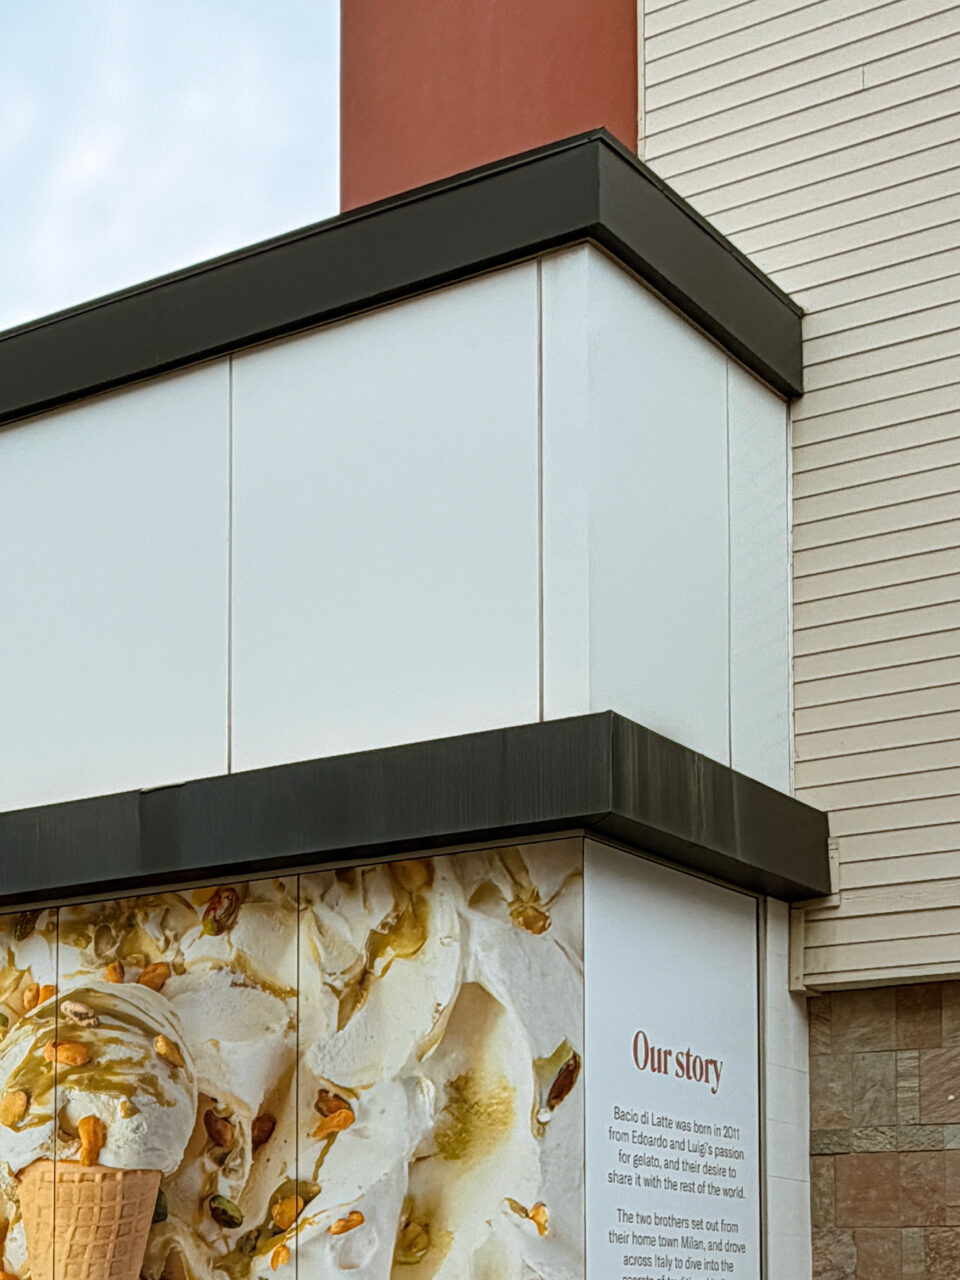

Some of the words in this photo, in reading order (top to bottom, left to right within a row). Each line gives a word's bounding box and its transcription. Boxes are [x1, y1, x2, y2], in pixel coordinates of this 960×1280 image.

[633, 1030, 671, 1075] Our
[675, 1048, 723, 1094] story
[614, 1106, 638, 1123] Bacio
[641, 1111, 649, 1125] di
[651, 1113, 672, 1129] Latte
[675, 1119, 691, 1131] was
[694, 1121, 712, 1135] born
[714, 1125, 721, 1136] in
[723, 1126, 740, 1140] 2011
[609, 1127, 629, 1142] from
[632, 1130, 667, 1148] Edoardo
[670, 1138, 685, 1151] and
[688, 1140, 712, 1157] Luigi's
[715, 1146, 744, 1160] passion
[618, 1150, 630, 1164] for
[633, 1153, 661, 1168] gelato,
[664, 1157, 679, 1170] and
[682, 1159, 700, 1173] their
[703, 1163, 726, 1176] desire
[729, 1167, 736, 1178] to
[608, 1171, 632, 1186] share
[635, 1173, 641, 1186] it
[644, 1174, 661, 1189] with
[664, 1178, 677, 1191] the
[680, 1182, 695, 1193] rest
[698, 1181, 705, 1194] of
[708, 1183, 720, 1196] the
[723, 1185, 745, 1199] world.
[617, 1209, 633, 1223] The
[636, 1212, 652, 1225] two
[655, 1213, 689, 1229] brothers
[691, 1218, 703, 1230] set
[706, 1220, 718, 1231] out
[721, 1219, 738, 1233] from
[609, 1231, 629, 1245] their
[632, 1234, 656, 1247] home
[659, 1237, 678, 1248] town
[681, 1238, 705, 1251] Milan,
[708, 1241, 722, 1251] and
[725, 1241, 746, 1254] drove
[623, 1255, 652, 1267] across
[655, 1255, 672, 1271] Italy
[675, 1257, 683, 1268] to
[685, 1257, 701, 1270] dive
[704, 1258, 719, 1271] into
[721, 1260, 733, 1272] the
